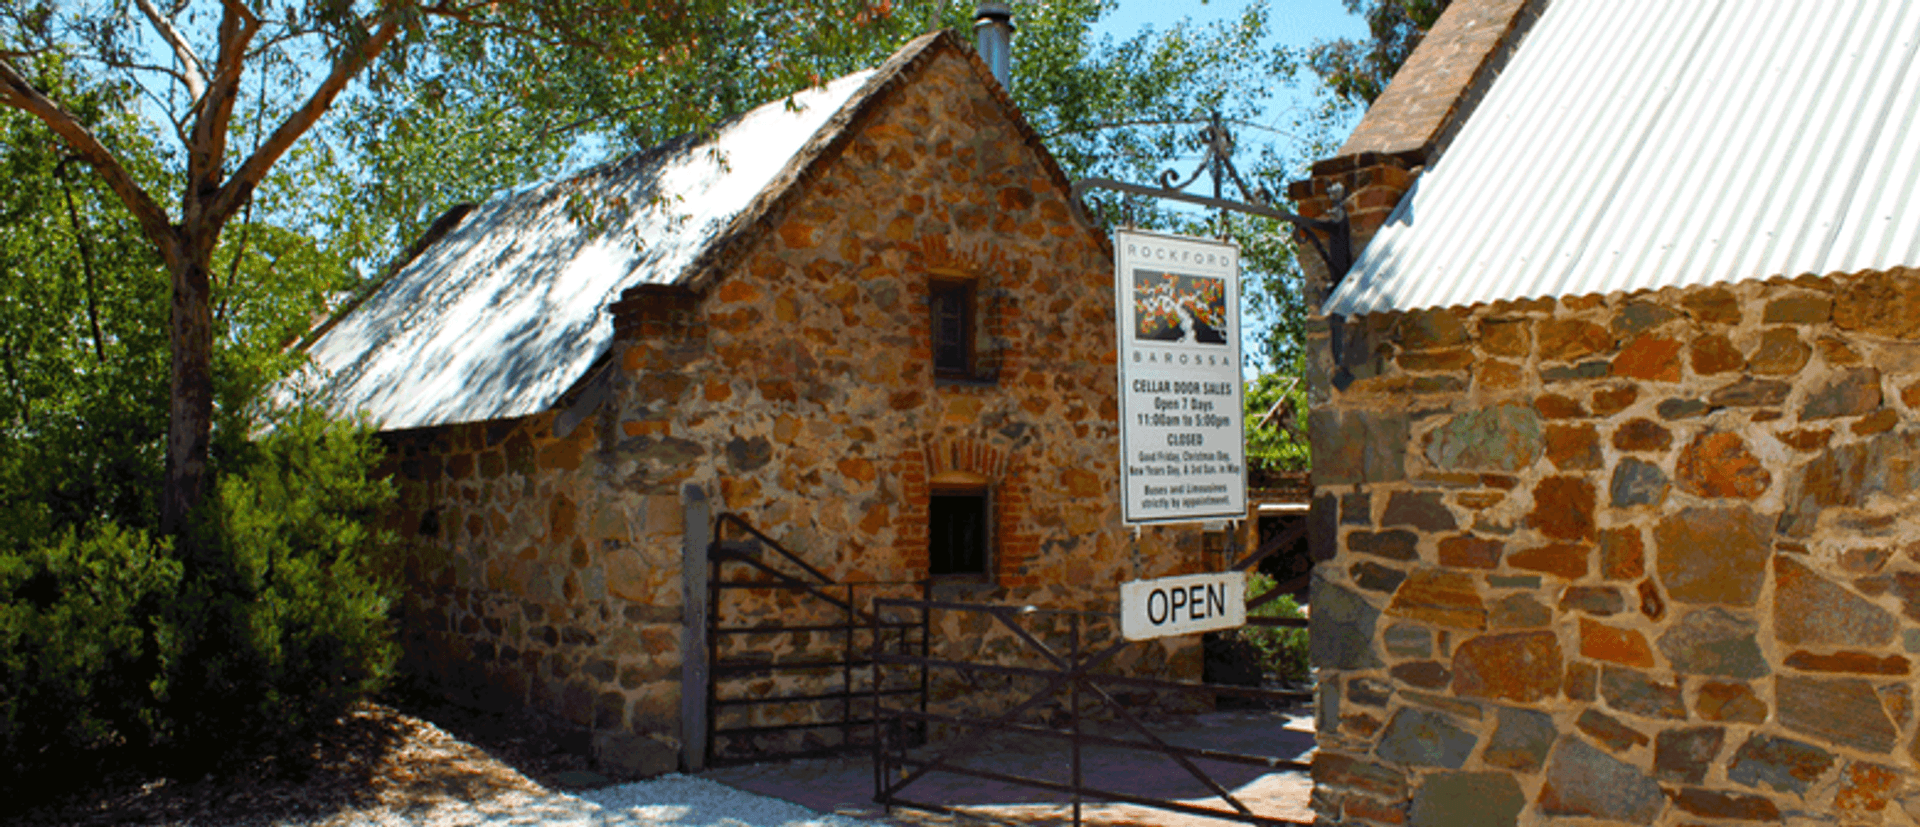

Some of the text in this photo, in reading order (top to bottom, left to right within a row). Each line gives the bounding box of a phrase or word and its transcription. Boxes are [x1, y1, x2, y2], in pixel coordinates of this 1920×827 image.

[1128, 244, 1229, 267] ROCKFORD
[1133, 351, 1229, 365] BAROSSA
[1133, 379, 1232, 395] CELLAR DOOR SALES
[1155, 397, 1214, 412] Open 7 Days
[1138, 413, 1231, 429] 11:00am to 5:00pm
[1167, 433, 1203, 446] CLOSED
[1139, 451, 1156, 461] Good
[1182, 451, 1215, 461] Christmas
[1130, 465, 1143, 476] New
[1219, 465, 1225, 473] in
[1145, 484, 1227, 495] Buses and Limousines
[1142, 498, 1169, 509] strictly
[1171, 498, 1180, 509] by
[1147, 582, 1224, 626] OPEN
